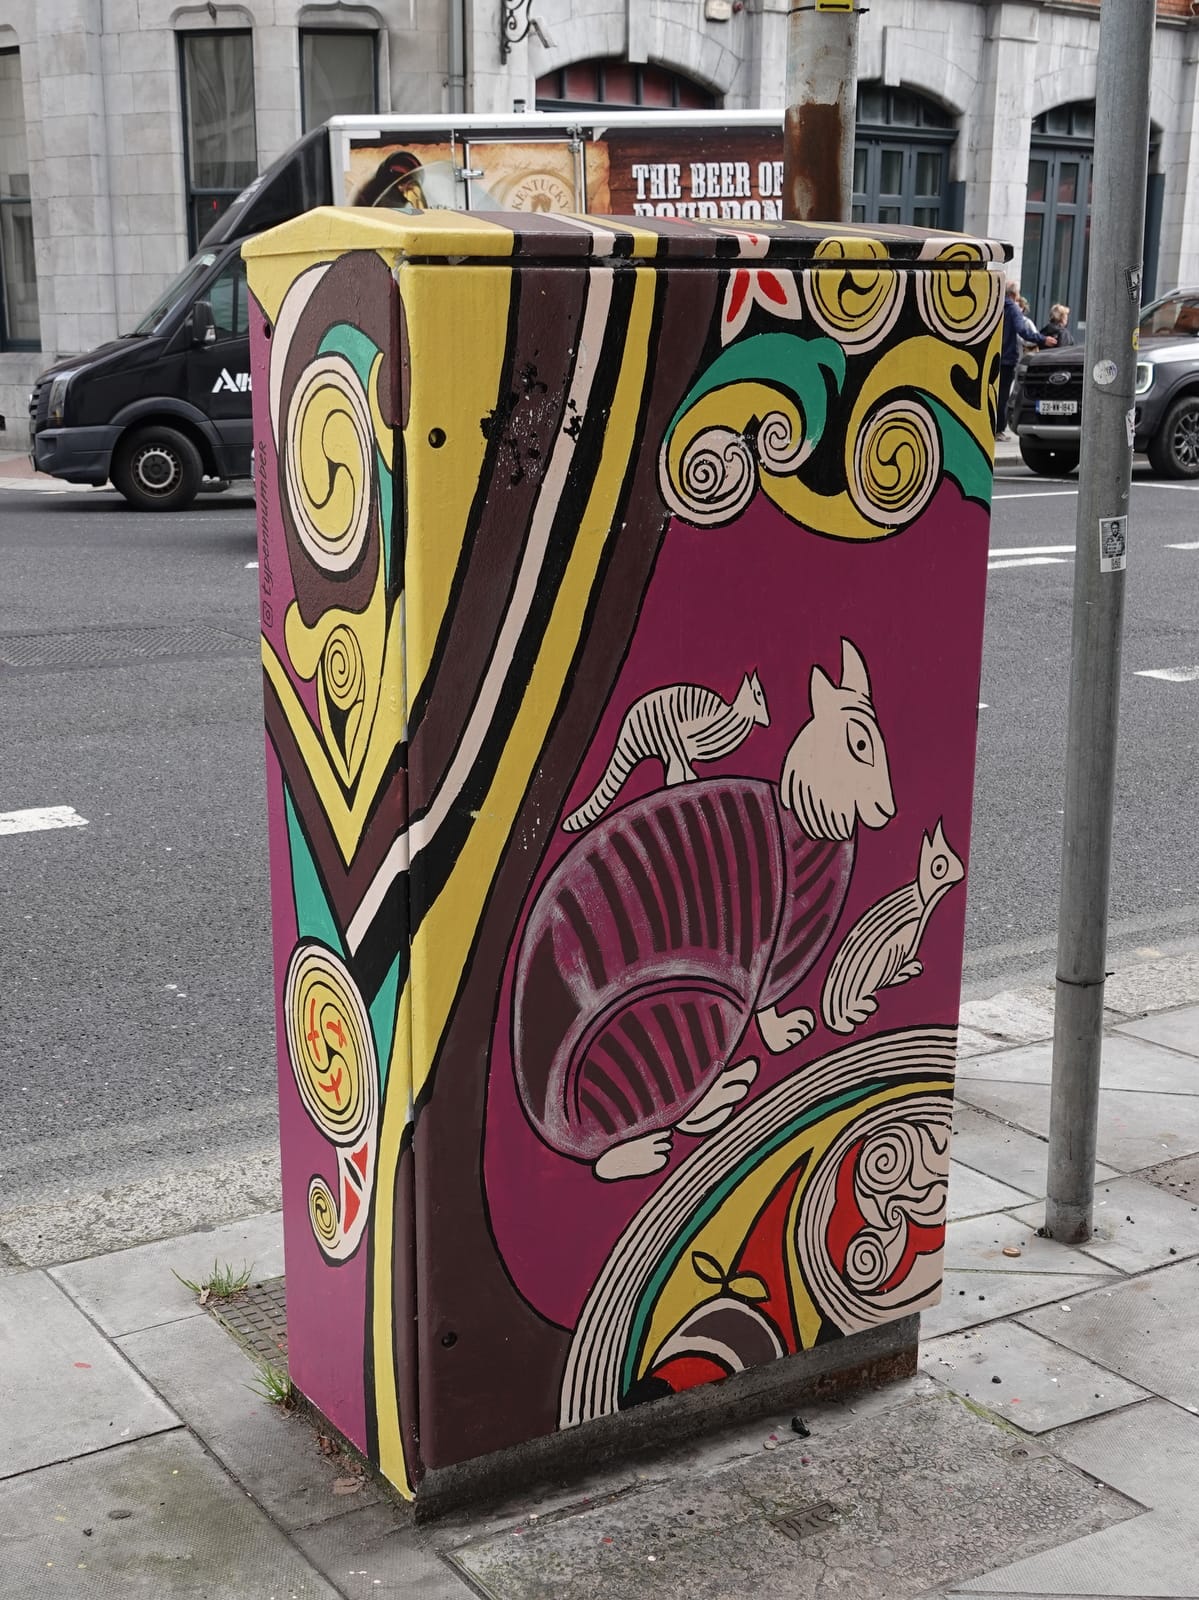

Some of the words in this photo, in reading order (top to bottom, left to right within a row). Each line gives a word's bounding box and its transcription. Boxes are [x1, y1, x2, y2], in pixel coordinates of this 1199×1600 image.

[512, 179, 569, 210] KENTUCKY
[632, 164, 681, 199] THE
[690, 162, 751, 198] BEER
[758, 161, 784, 196] OF
